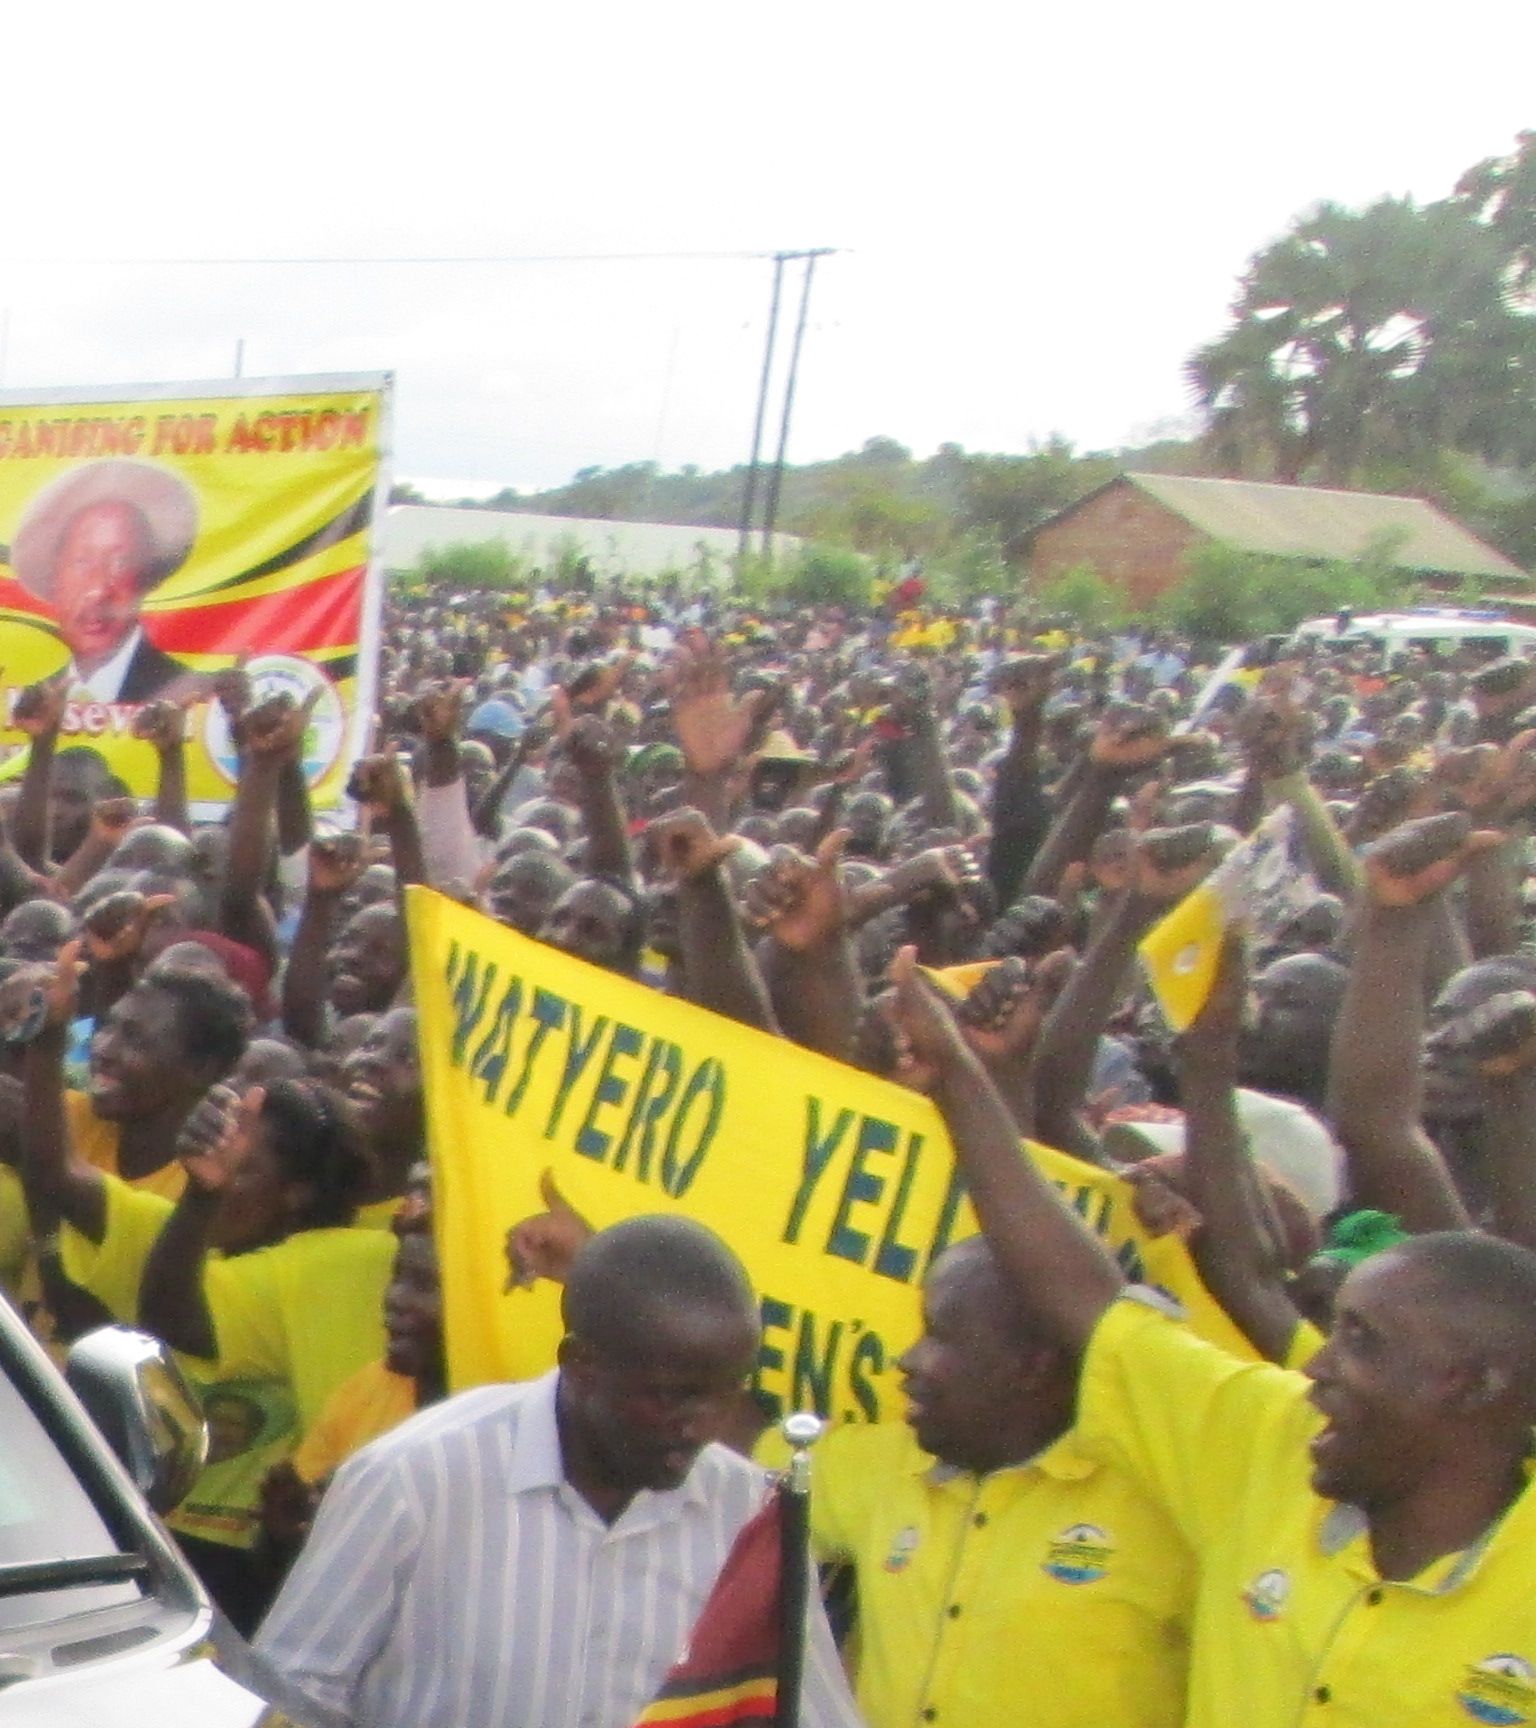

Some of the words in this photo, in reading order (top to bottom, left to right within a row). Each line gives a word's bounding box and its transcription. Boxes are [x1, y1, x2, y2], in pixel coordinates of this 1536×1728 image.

[149, 412, 219, 457] FOR
[224, 405, 372, 455] ACTION
[446, 938, 728, 1199] WATYERO
